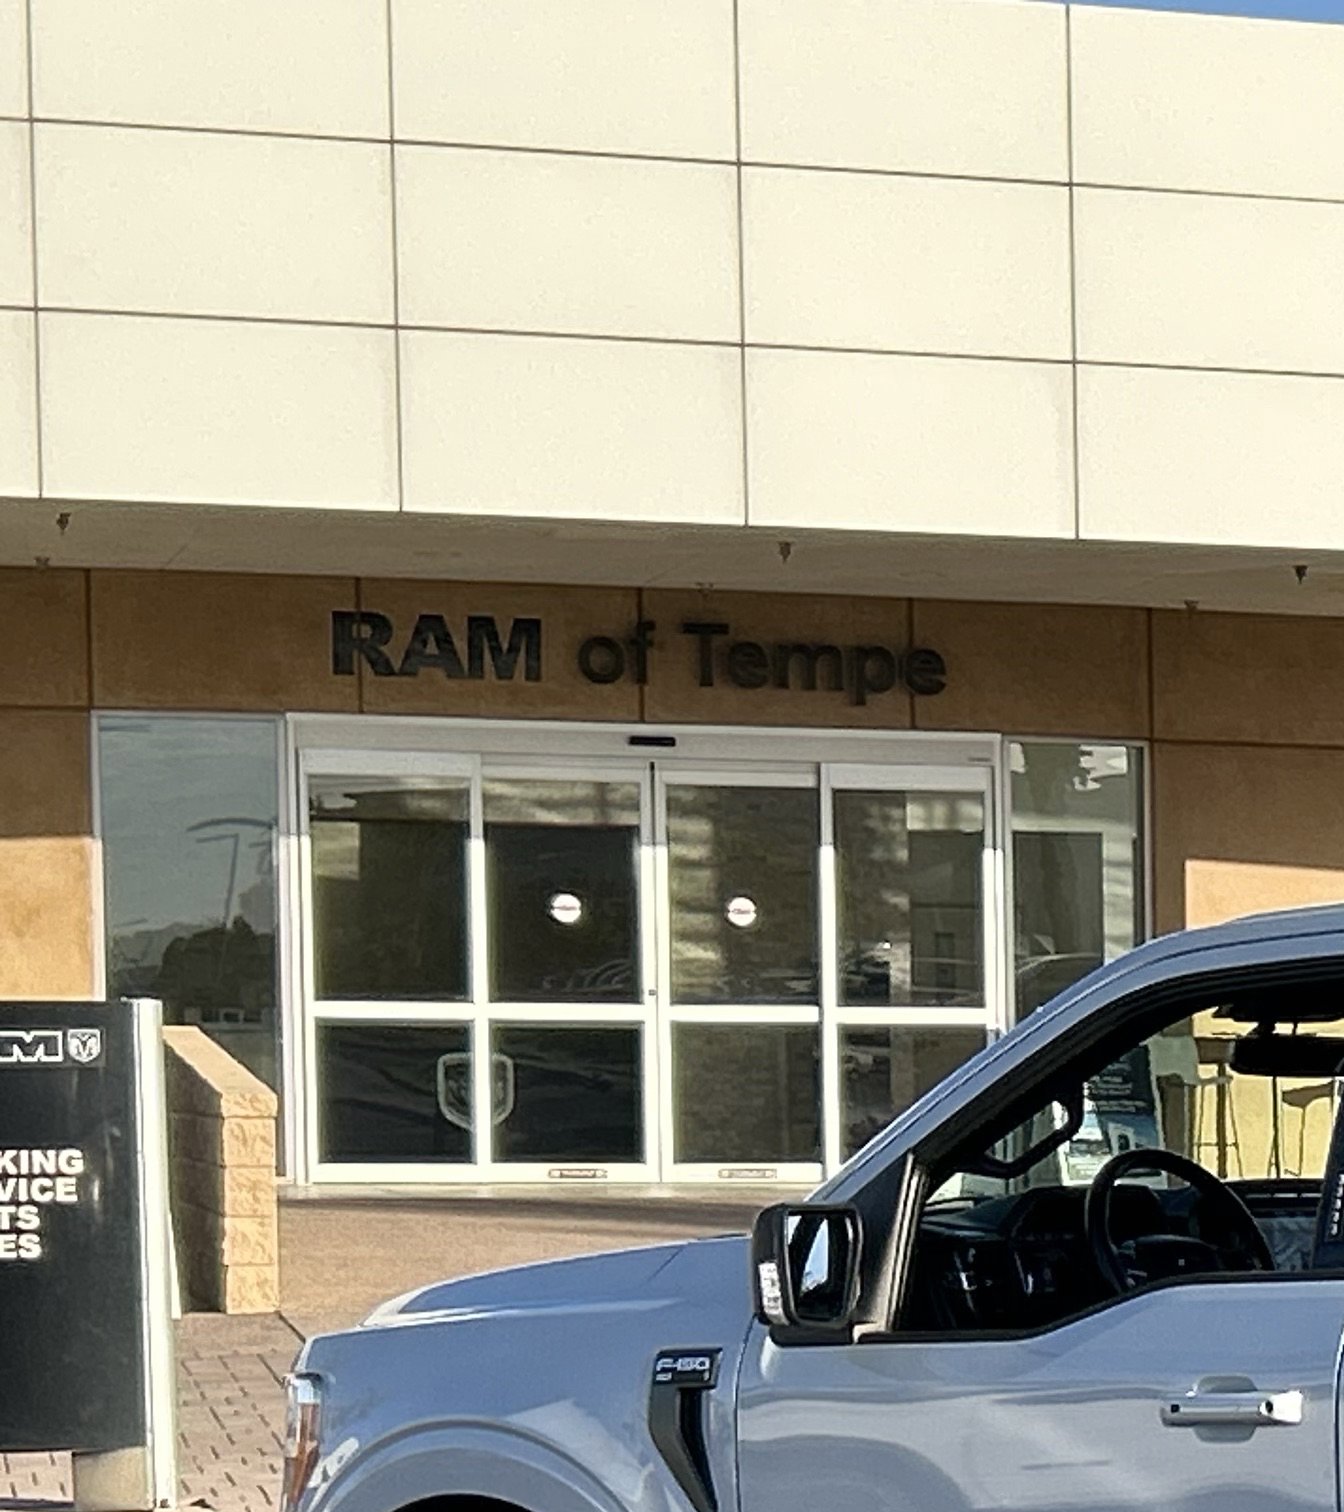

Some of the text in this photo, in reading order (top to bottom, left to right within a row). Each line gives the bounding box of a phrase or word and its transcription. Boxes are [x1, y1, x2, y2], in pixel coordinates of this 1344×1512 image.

[331, 610, 947, 706] RAM of Tempe
